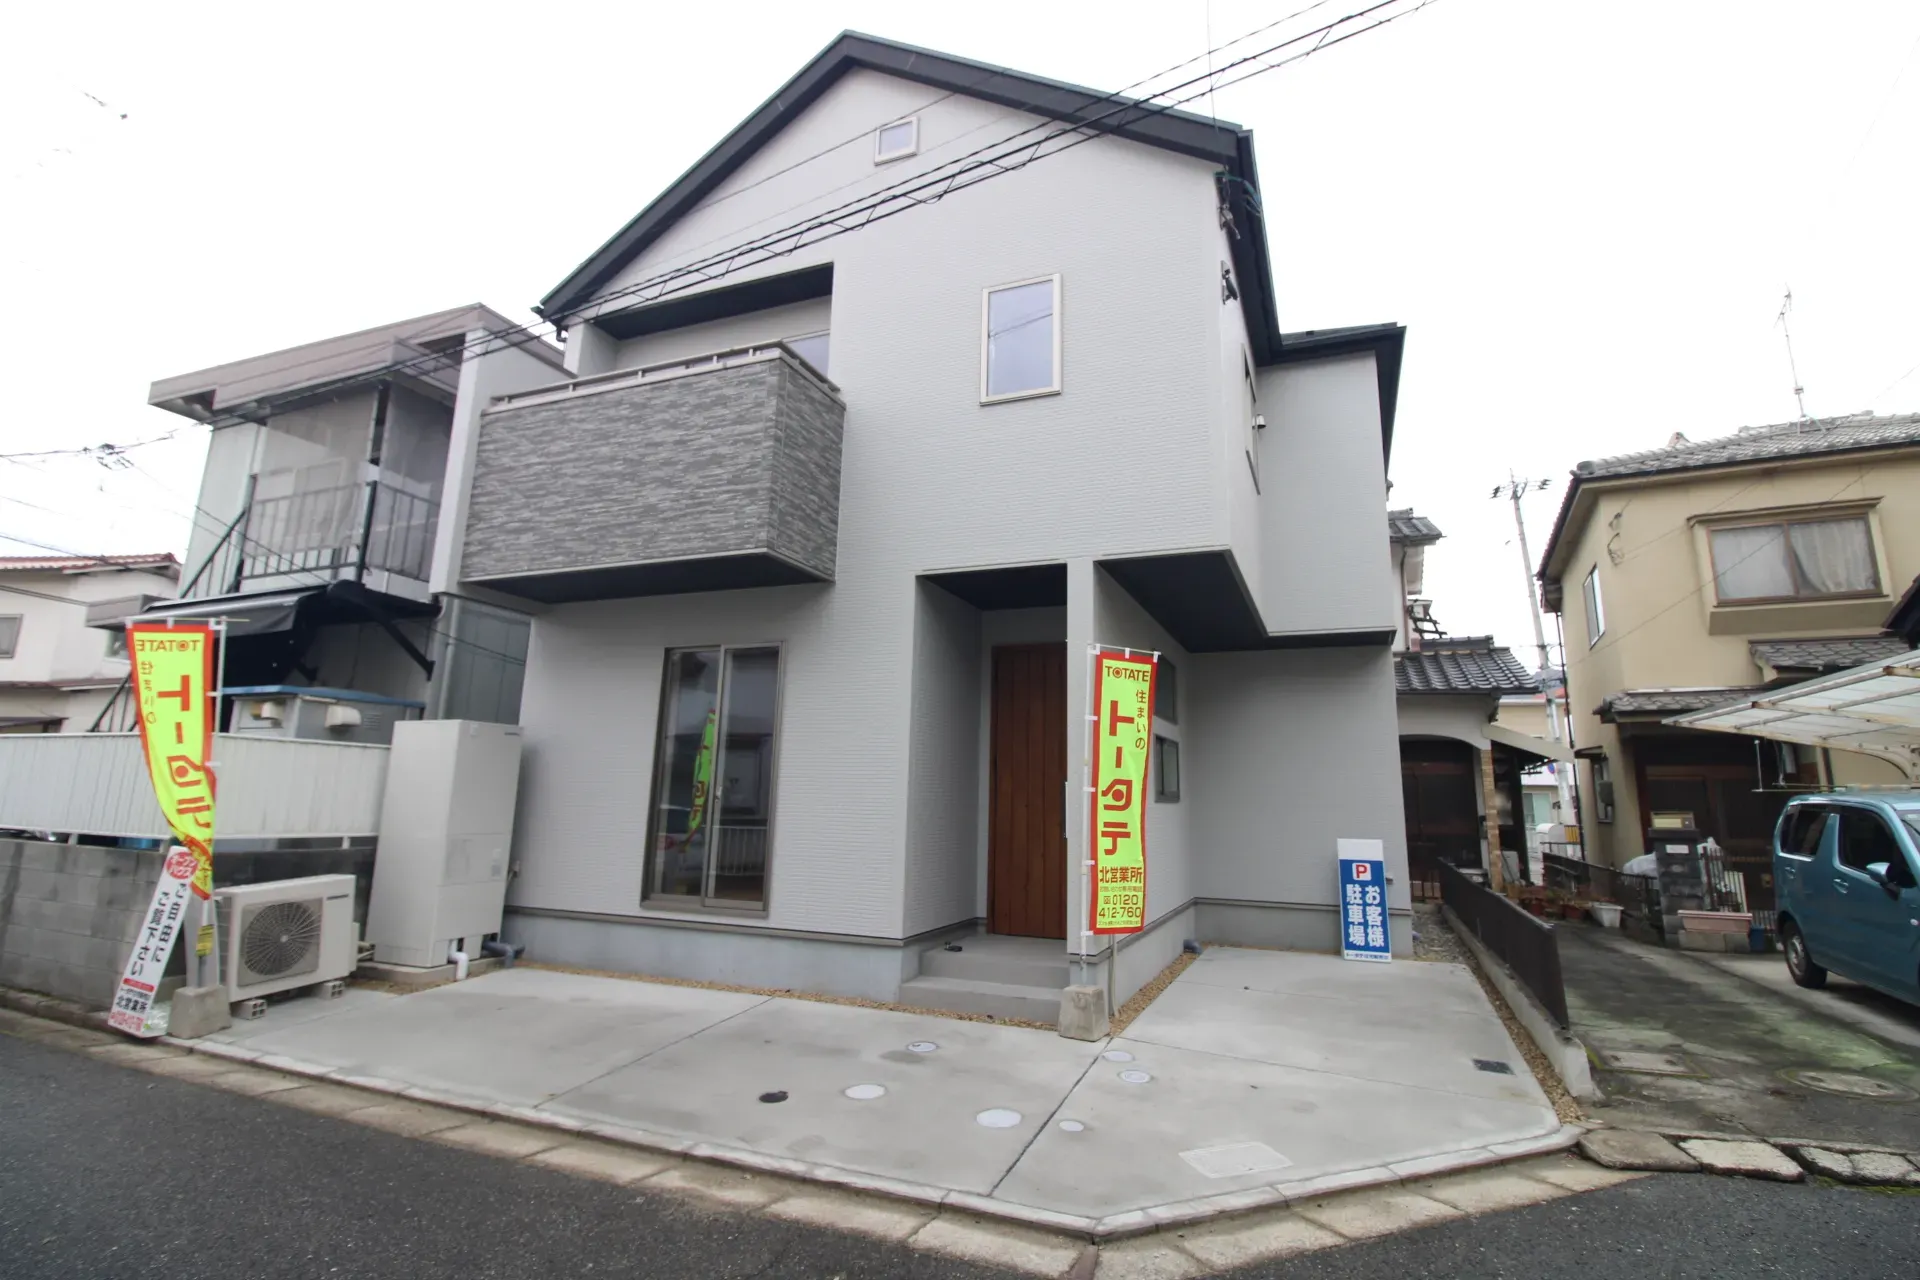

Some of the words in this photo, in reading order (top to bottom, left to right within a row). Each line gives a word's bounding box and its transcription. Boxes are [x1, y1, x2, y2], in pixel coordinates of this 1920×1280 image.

[1105, 666, 1150, 682] TOTATE
[1135, 689, 1147, 750] 住まいの
[1101, 700, 1135, 856] トータテ
[1099, 866, 1143, 884] 北営業所
[1112, 894, 1139, 905] 0120
[1356, 864, 1367, 878] P
[131, 892, 170, 976] ご覧下さい
[151, 882, 187, 963] ご自由に
[1098, 906, 1142, 919] 412-760
[1346, 884, 1366, 946] 駐車場
[1365, 885, 1385, 947] お客様
